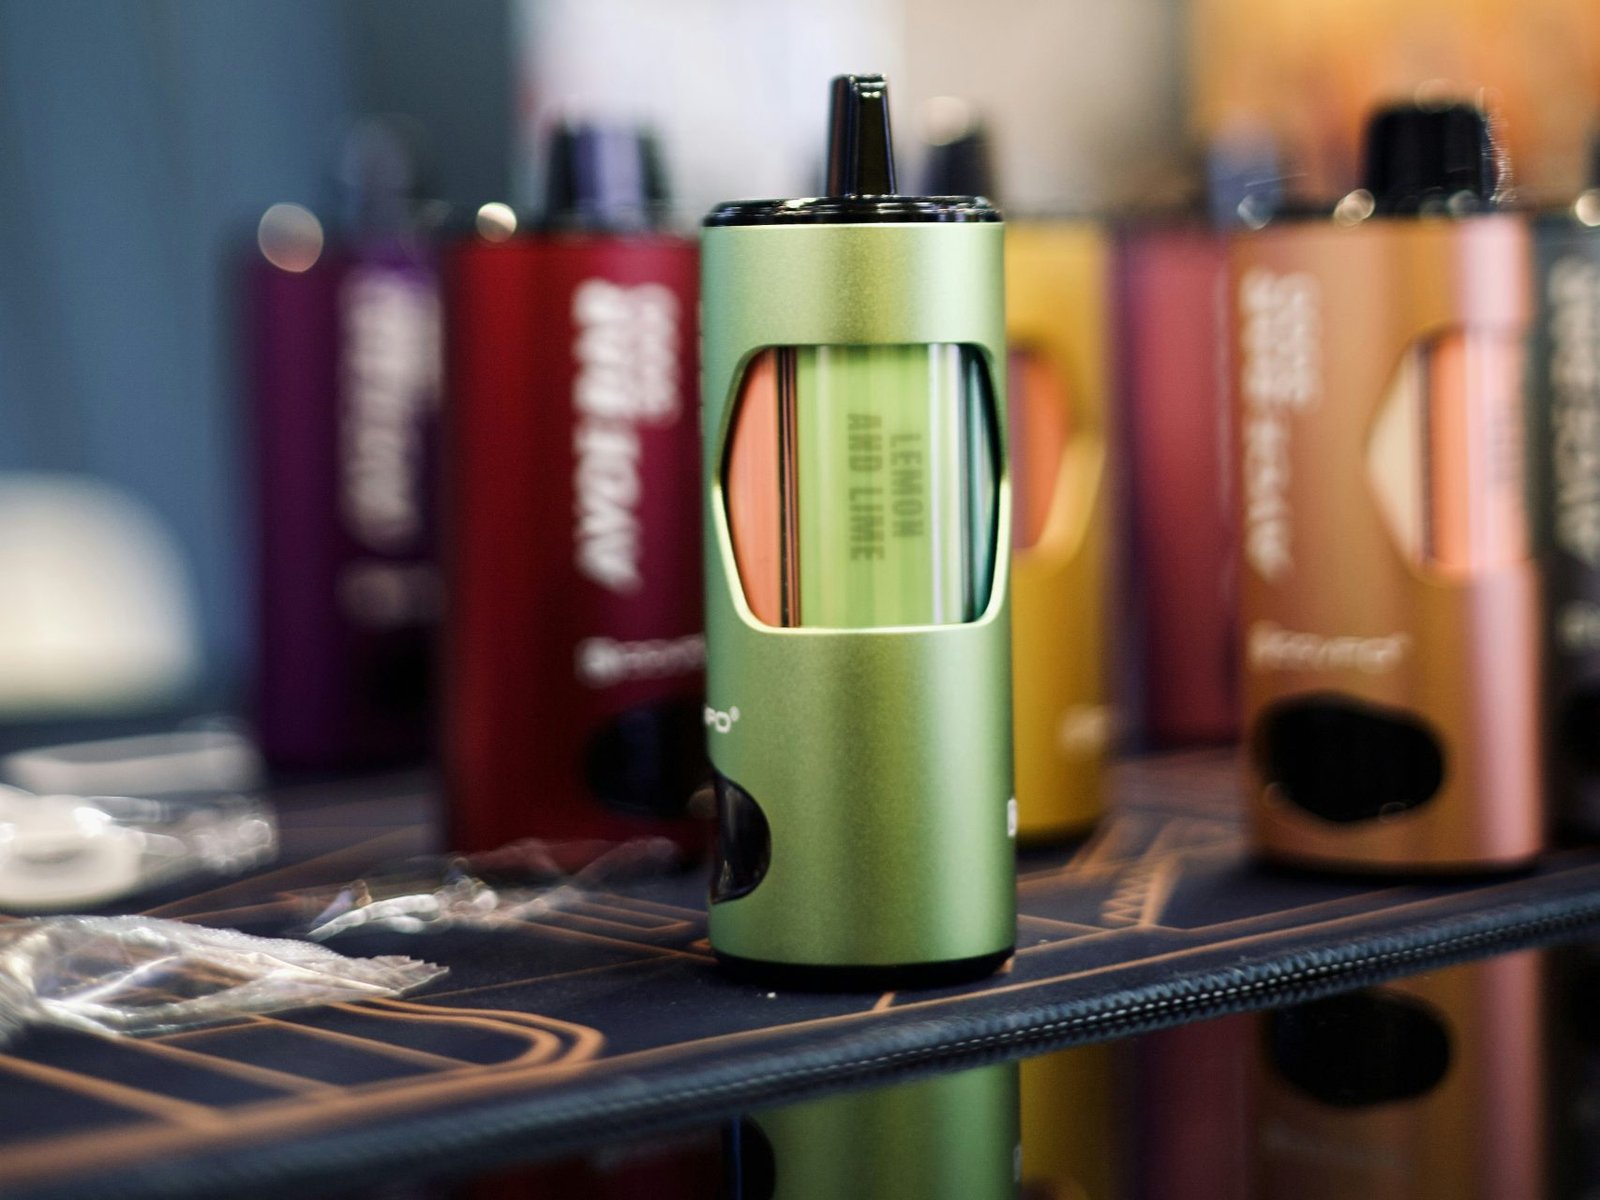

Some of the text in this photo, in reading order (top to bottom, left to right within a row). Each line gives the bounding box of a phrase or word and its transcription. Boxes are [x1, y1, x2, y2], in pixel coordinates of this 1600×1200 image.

[847, 413, 886, 561] AND LIME
[889, 432, 924, 538] LEMON
